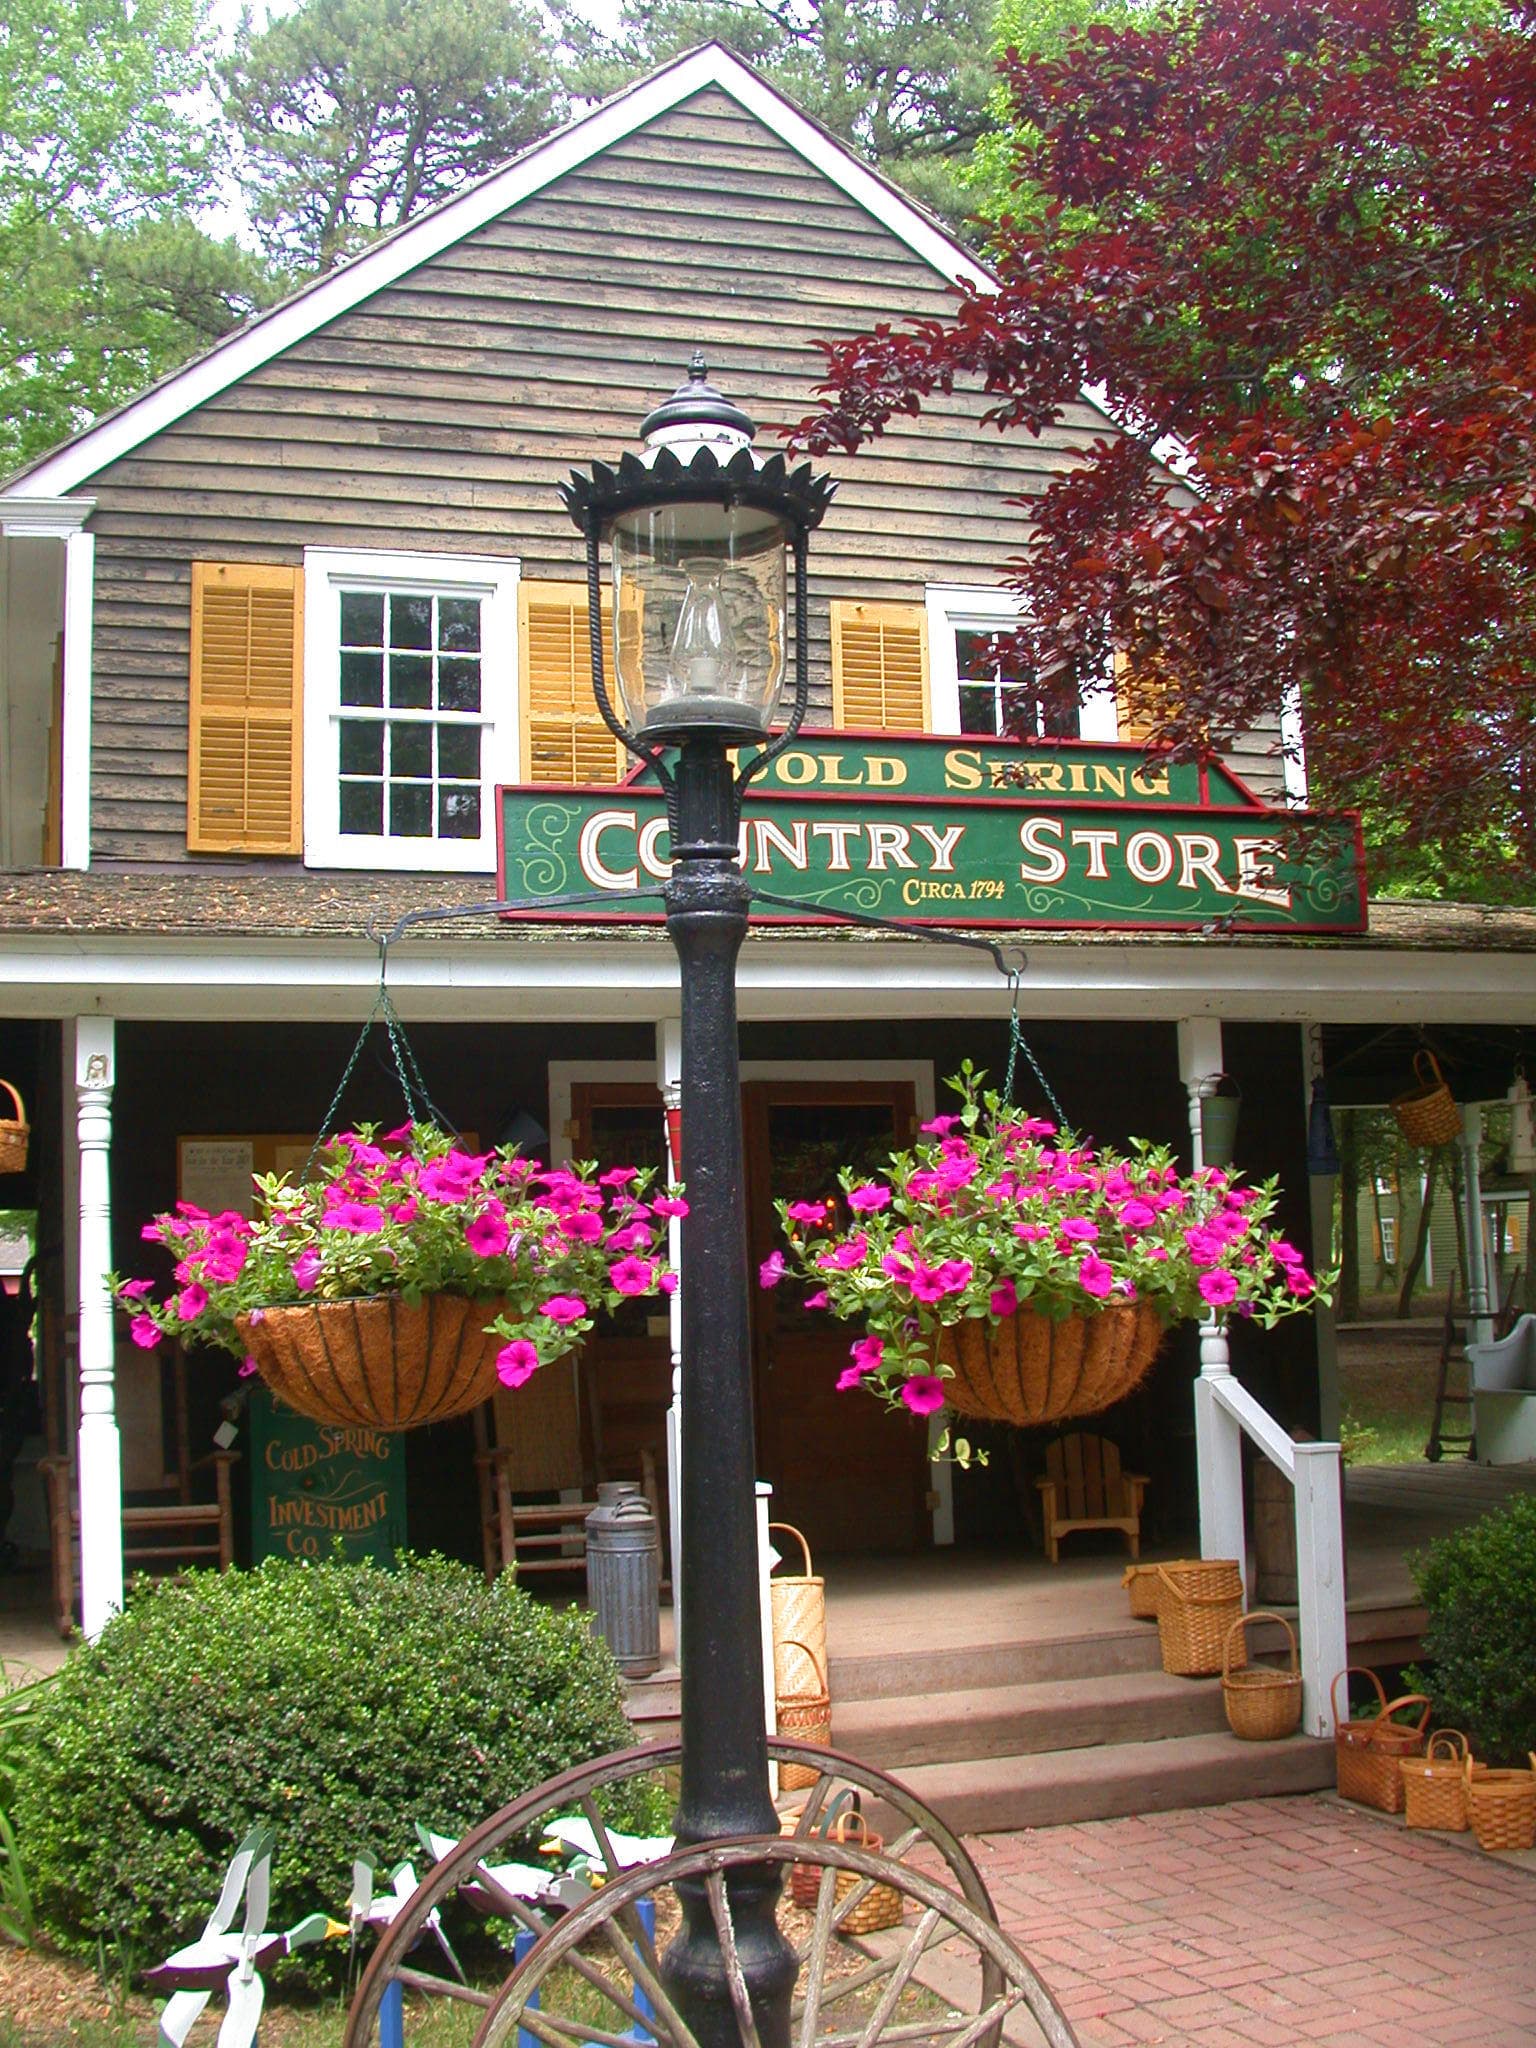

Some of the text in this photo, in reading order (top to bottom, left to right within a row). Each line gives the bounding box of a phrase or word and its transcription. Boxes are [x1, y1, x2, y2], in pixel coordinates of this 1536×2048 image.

[1019, 816, 1293, 909] STORE
[902, 877, 1006, 906] CIRCA 1794
[265, 1427, 389, 1471] COLD SPRING
[269, 1492, 387, 1531] INVESTMENT
